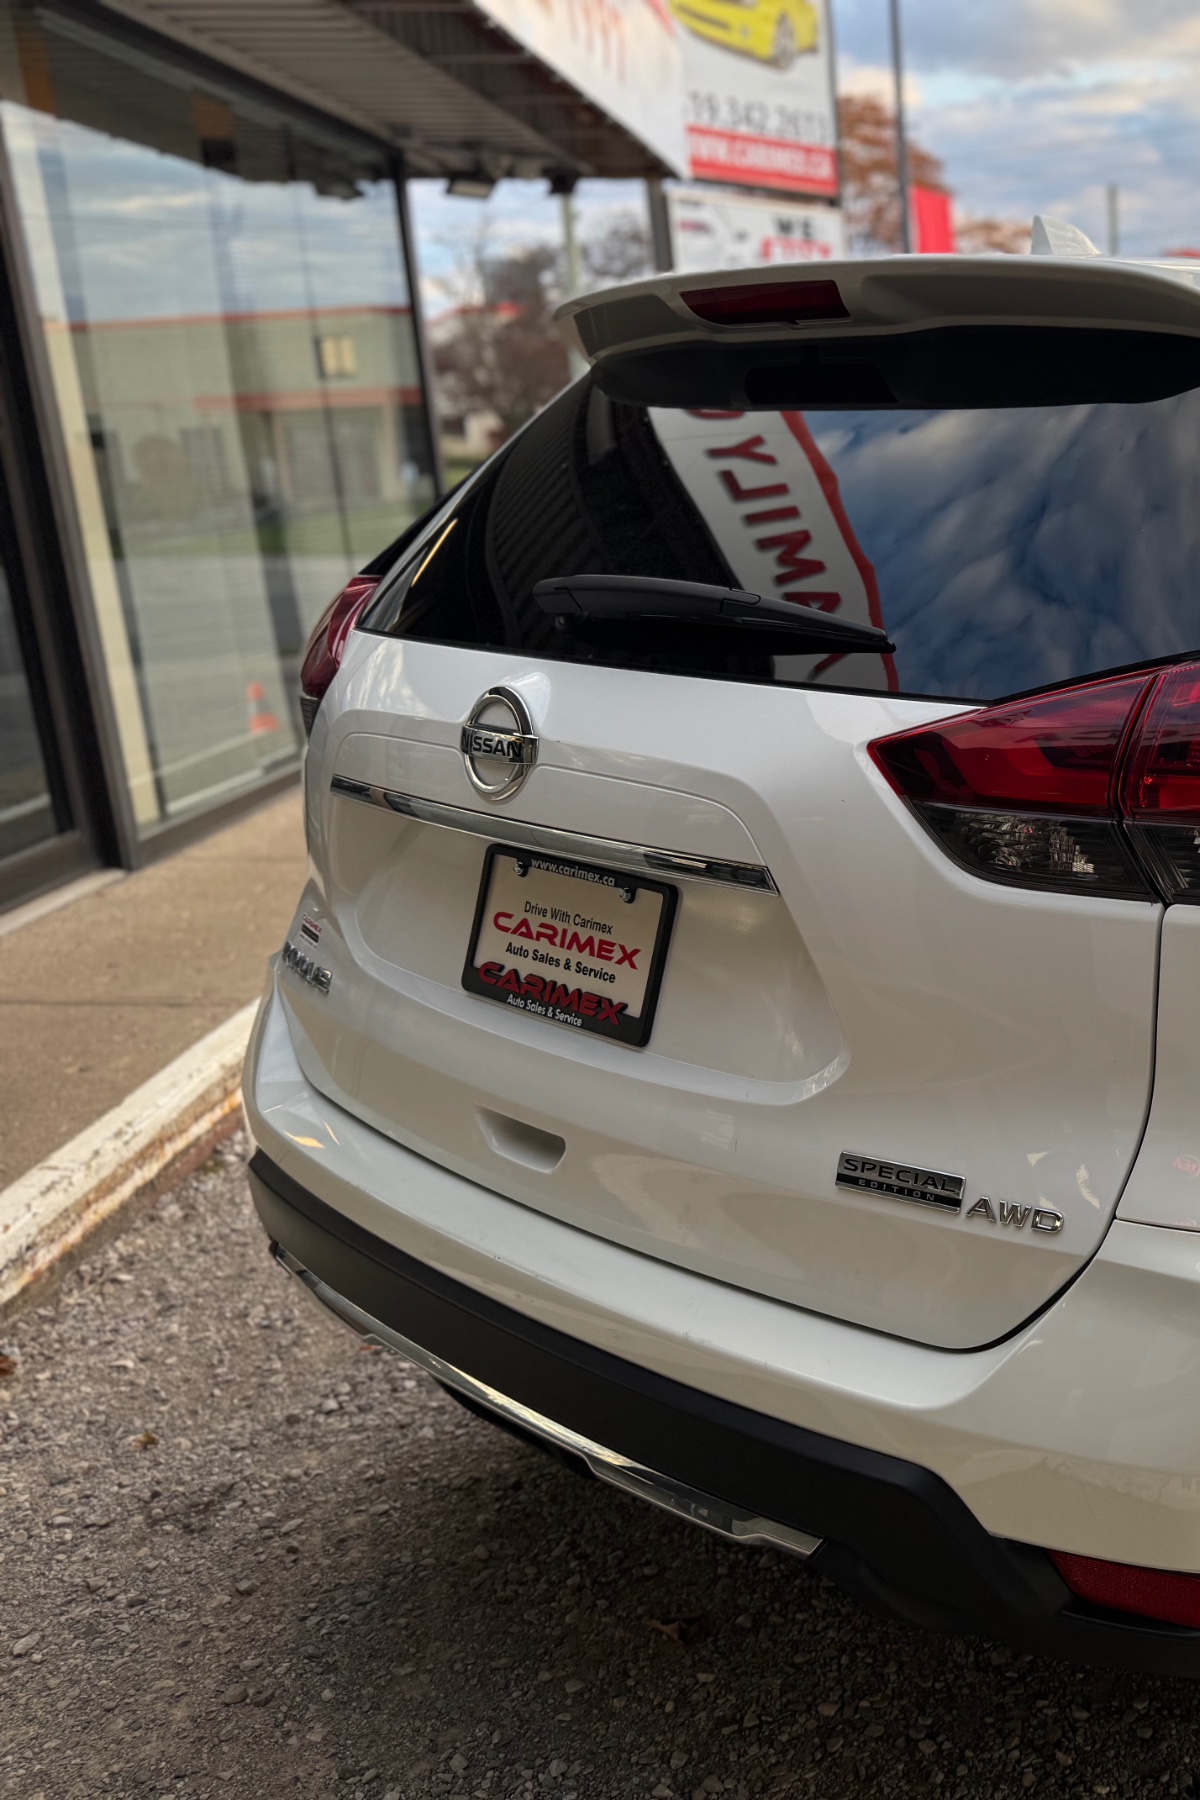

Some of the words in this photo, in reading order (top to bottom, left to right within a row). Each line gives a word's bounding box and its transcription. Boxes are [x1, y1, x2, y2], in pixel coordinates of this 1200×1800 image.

[461, 730, 522, 758] NISSAN
[531, 859, 615, 886] www.carimex.ca
[524, 901, 547, 918] Drive
[550, 907, 571, 924] With
[573, 913, 613, 935] Carimex
[493, 911, 642, 970] CARIMEX
[505, 941, 529, 959] Auto
[532, 948, 561, 968] Sales
[564, 958, 571, 971] &
[575, 961, 616, 983] Service
[478, 961, 627, 1026] CARIMEX
[507, 993, 524, 1009] Auto
[526, 999, 546, 1015] Sales
[547, 1006, 553, 1018] &
[555, 1009, 583, 1027] Service
[843, 1158, 959, 1194] SPECIAL
[858, 1178, 936, 1201] EDITION
[965, 1196, 1065, 1234] AWD
